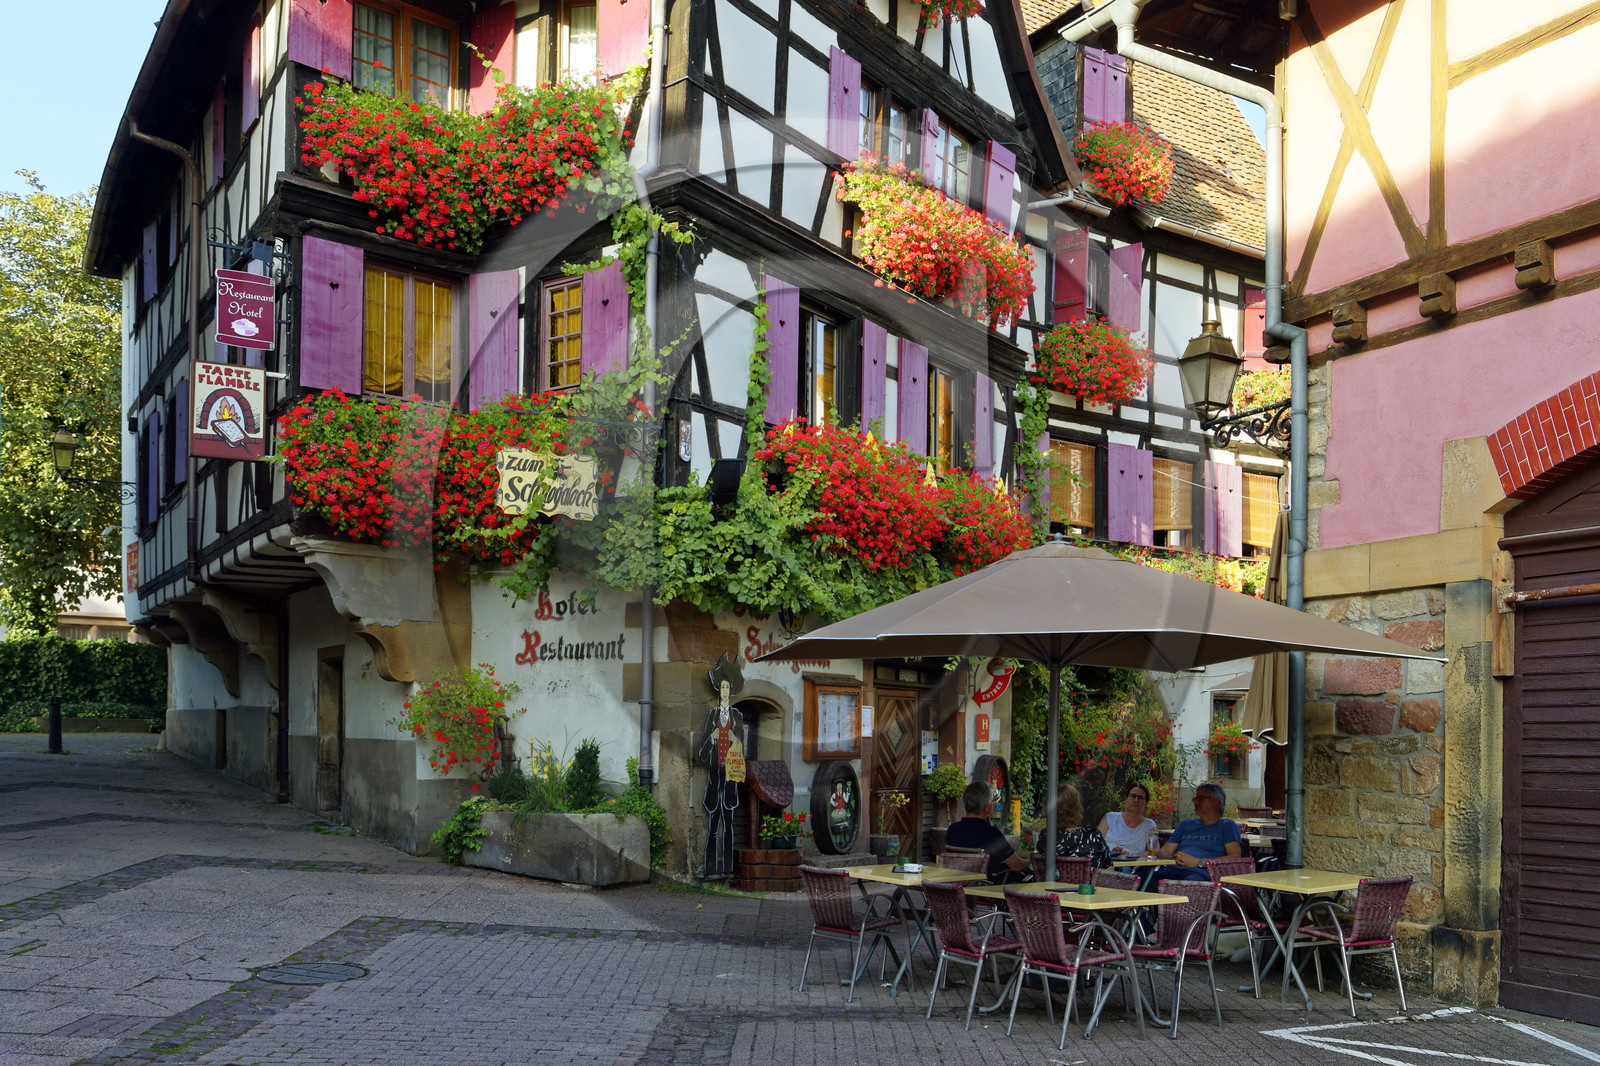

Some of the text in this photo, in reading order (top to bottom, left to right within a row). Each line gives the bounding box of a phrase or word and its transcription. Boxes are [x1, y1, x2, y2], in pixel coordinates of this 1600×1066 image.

[218, 281, 274, 303] Restaurant
[228, 301, 263, 319] Hotel
[202, 364, 251, 380] TARTE
[515, 628, 626, 666] Restaurant
[982, 719, 988, 730] H
